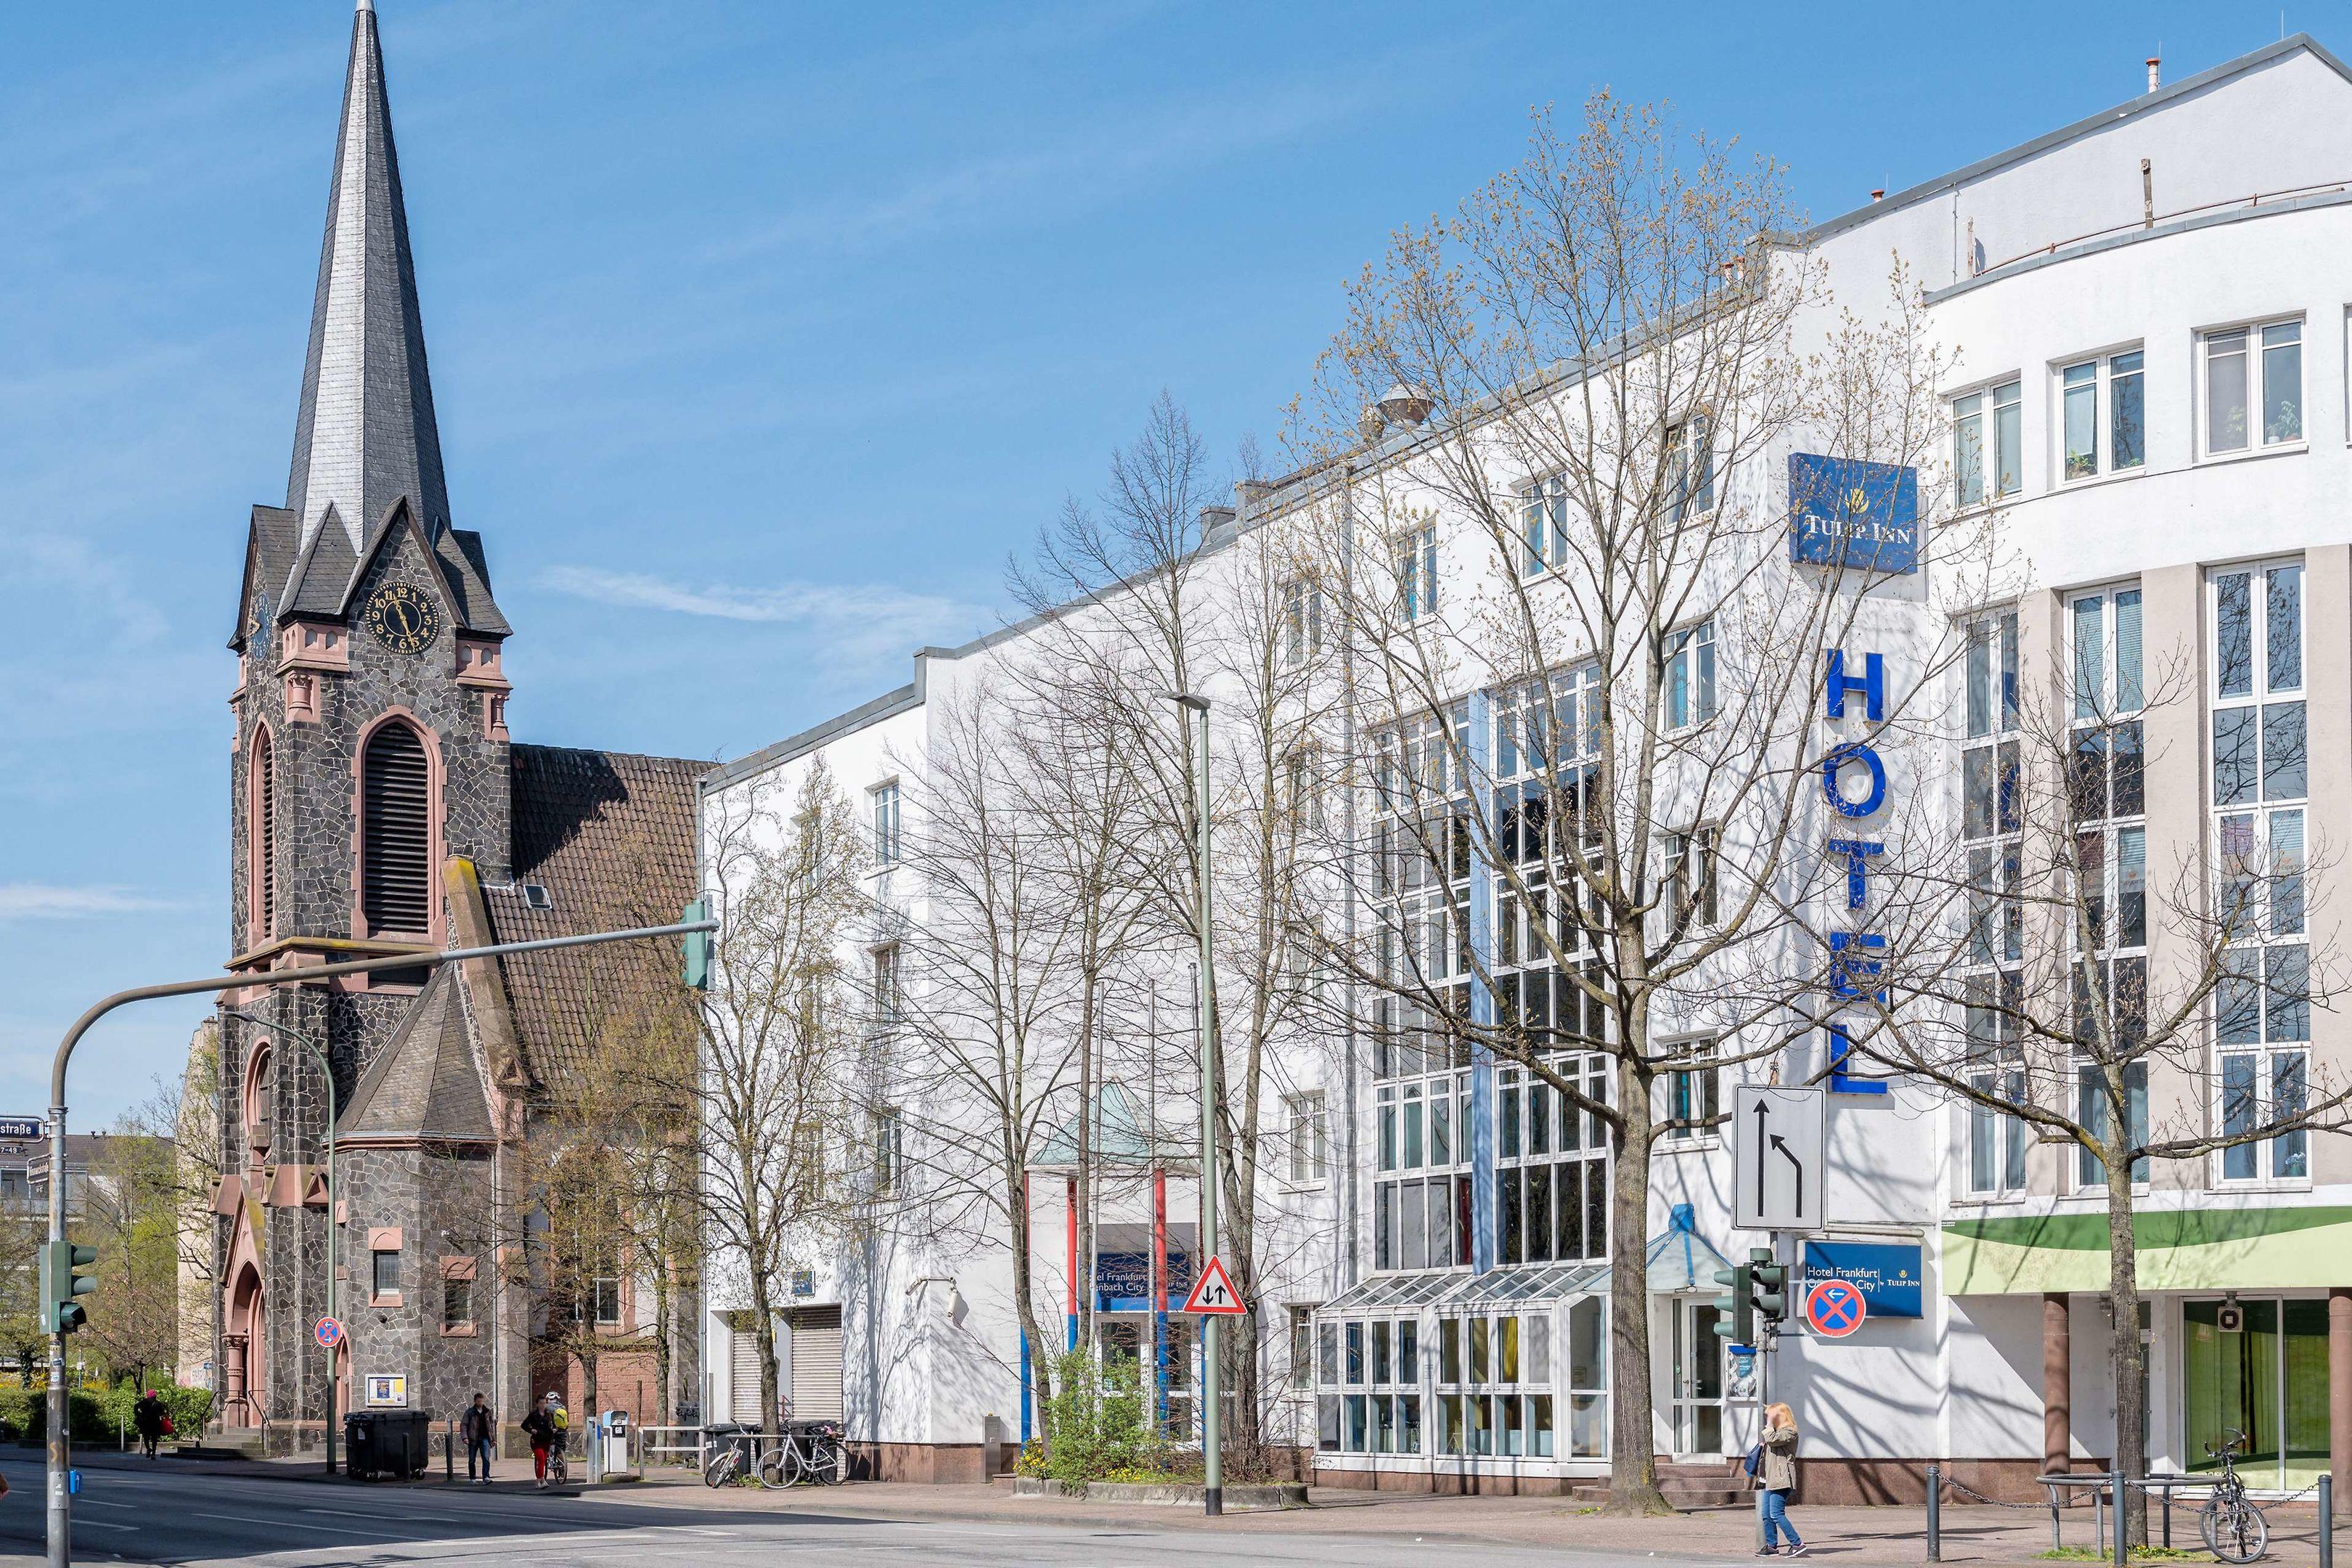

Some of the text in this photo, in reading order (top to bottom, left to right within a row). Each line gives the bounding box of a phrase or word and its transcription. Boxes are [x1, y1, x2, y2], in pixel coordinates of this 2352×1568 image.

[384, 590, 393, 600] 11
[396, 587, 407, 597] 12
[412, 592, 417, 602] 1
[374, 598, 386, 608] 10
[420, 602, 428, 612] 2
[372, 611, 380, 621] 9
[424, 616, 432, 625] 3
[376, 624, 384, 634] 8
[421, 628, 429, 638] 4
[386, 634, 394, 645] 7
[399, 638, 407, 649] 6
[1823, 649, 1887, 1094] HOTEL
[0, 1123, 31, 1135] straße
[1808, 1267, 1878, 1278] Hotel Frankfurt
[1127, 1283, 1144, 1293] City
[1856, 1280, 1875, 1293] City
